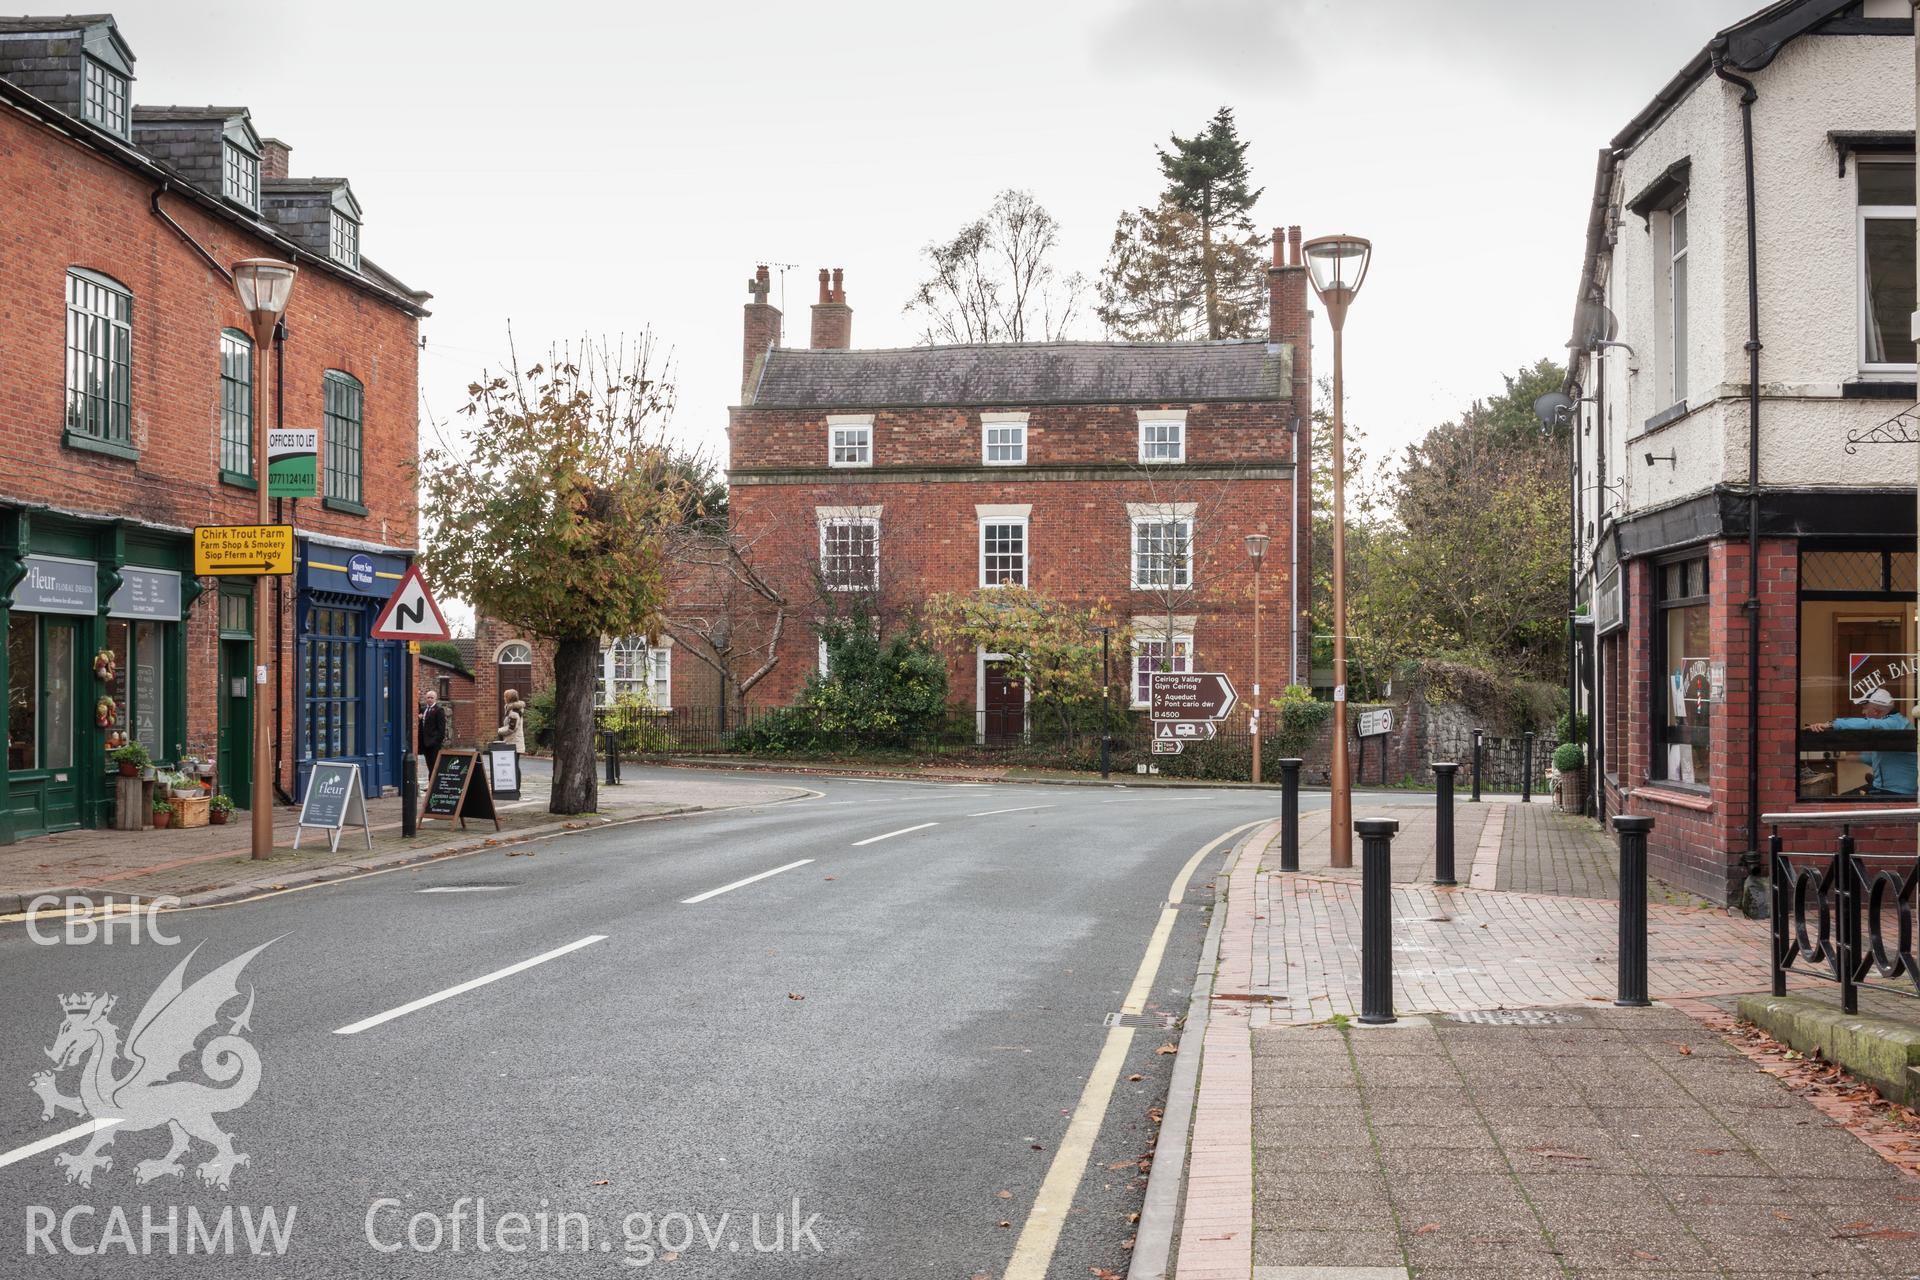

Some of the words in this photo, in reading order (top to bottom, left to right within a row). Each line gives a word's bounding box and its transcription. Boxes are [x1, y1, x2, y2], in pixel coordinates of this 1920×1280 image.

[270, 434, 294, 448] OFFICES
[296, 434, 304, 448] TO
[306, 434, 315, 447] LET
[268, 473, 314, 485] 07711241411
[202, 529, 228, 539] Chirk
[230, 528, 256, 539] Trout
[260, 528, 285, 538] Farm
[200, 541, 220, 550] Farm
[222, 540, 242, 550] Shop
[244, 540, 249, 548] &
[252, 540, 286, 549] Smokery
[205, 551, 222, 560] Siop
[224, 550, 247, 558] Fferm
[256, 550, 281, 560] Mygdy
[31, 566, 56, 590] fleur
[56, 583, 74, 592] FLORAL
[76, 584, 93, 593] DESIGN
[1853, 669, 1886, 696] THE
[320, 782, 344, 794] fleur
